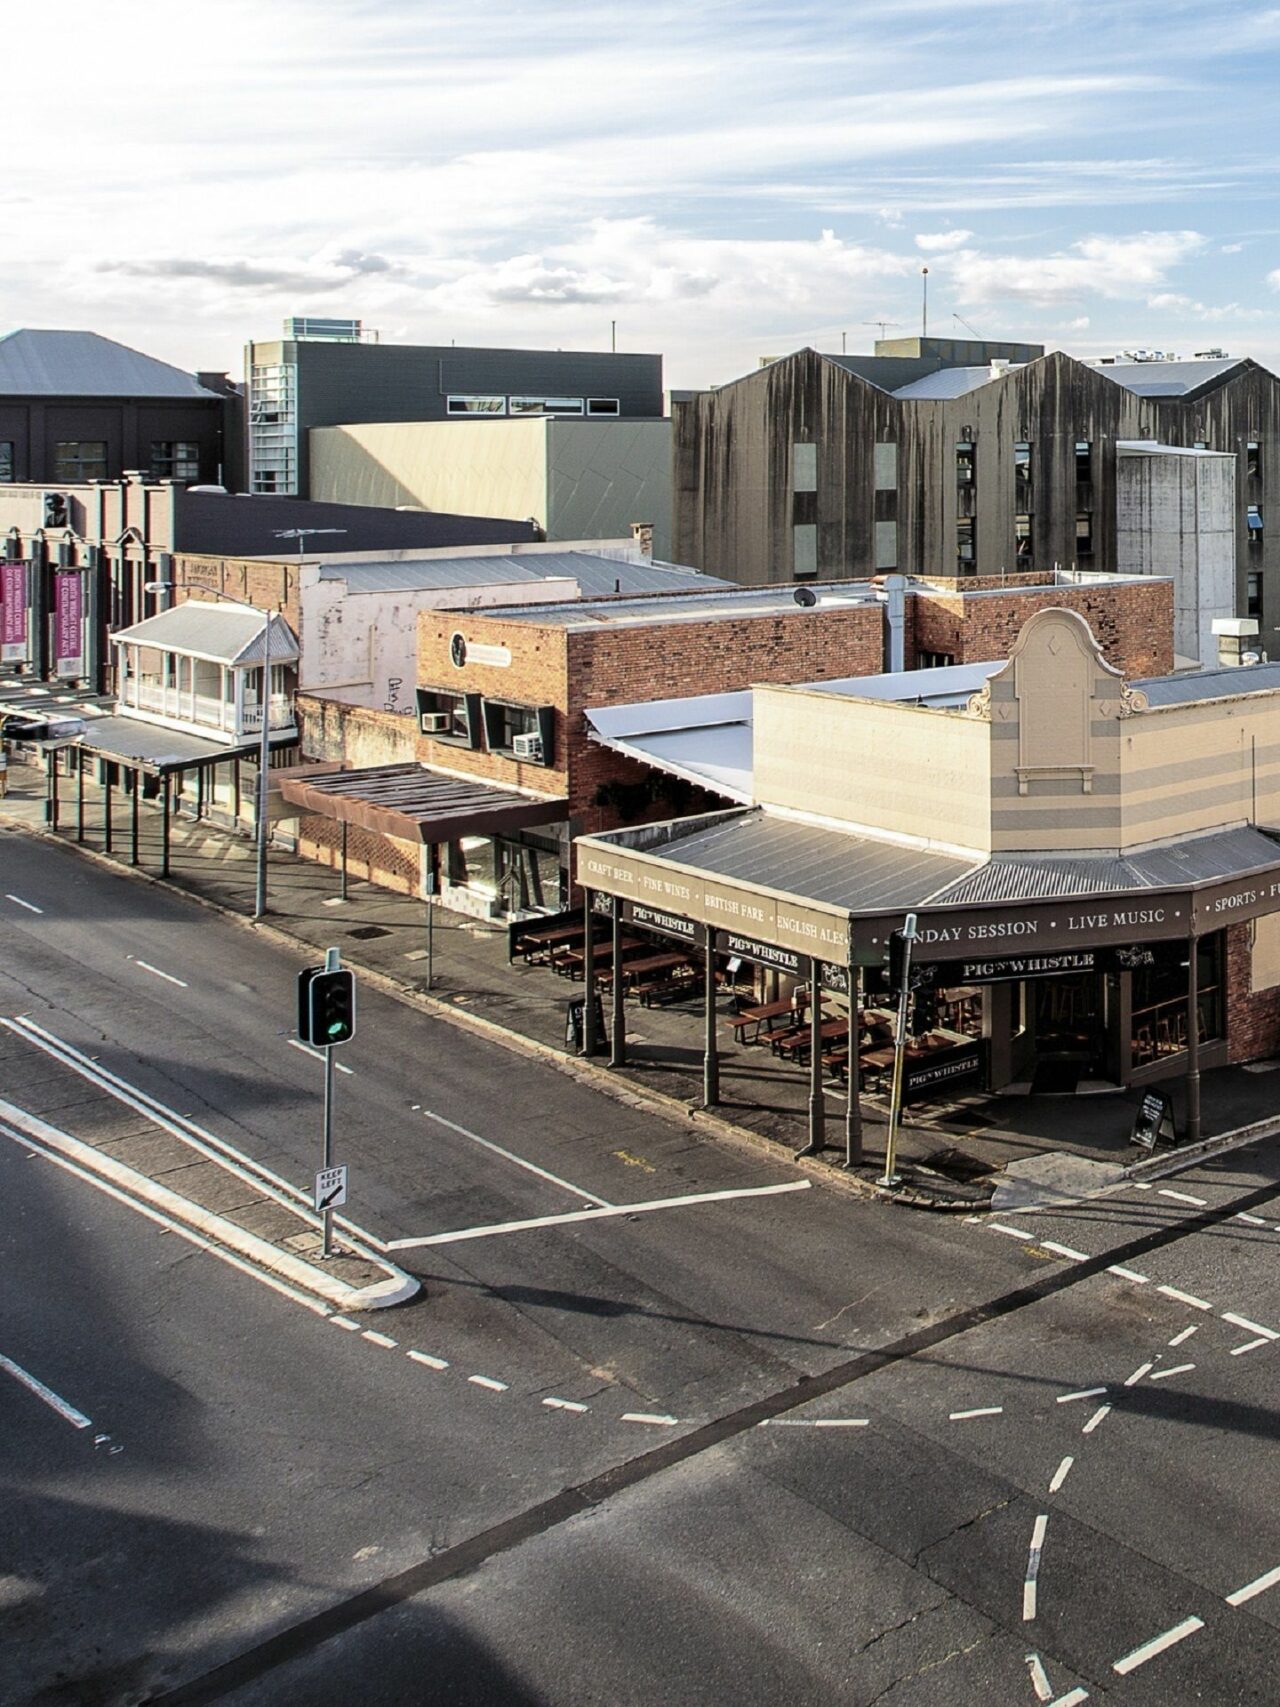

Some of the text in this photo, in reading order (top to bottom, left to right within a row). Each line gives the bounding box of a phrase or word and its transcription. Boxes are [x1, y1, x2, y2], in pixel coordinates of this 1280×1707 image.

[587, 860, 634, 883] CRAFT BEER
[644, 876, 690, 900] FINE WINES
[704, 894, 764, 922] BRITISH FARE
[1215, 890, 1257, 912] SPORTS
[777, 915, 845, 946] ENGLISH ALES
[968, 920, 1039, 940] SESSION
[1068, 909, 1165, 930] LIVE MUSIC
[321, 1169, 343, 1180] KEEP
[321, 1177, 342, 1190] LEFT
